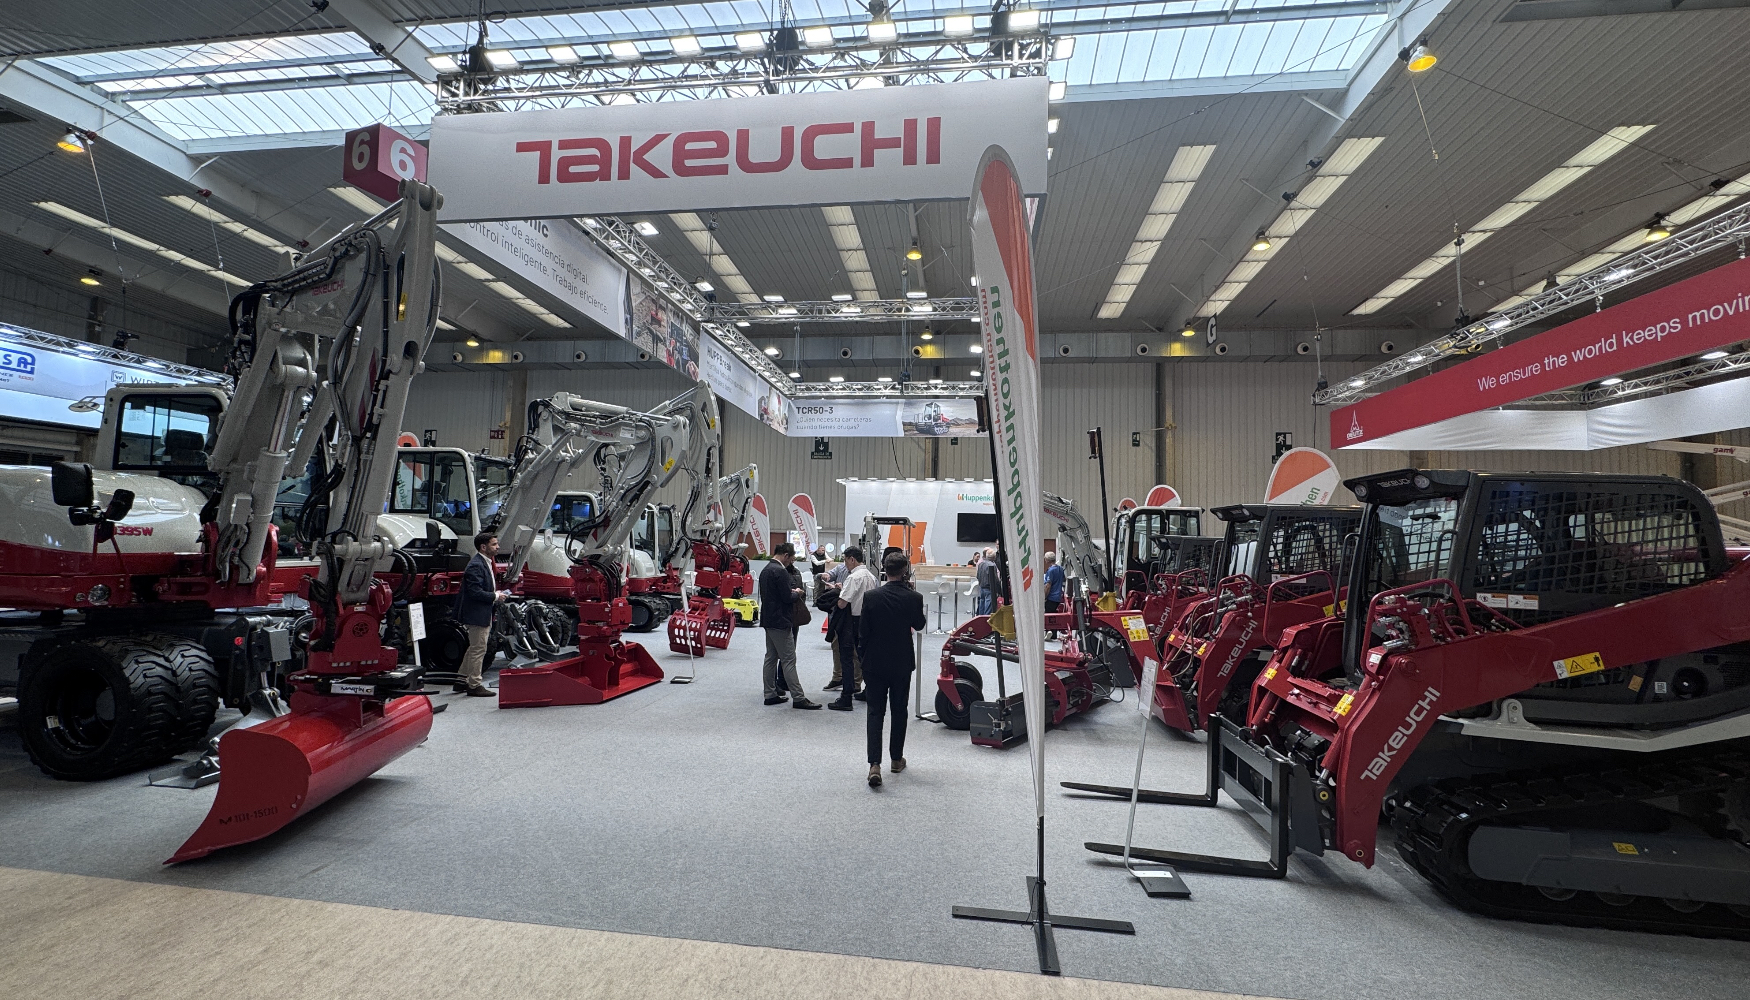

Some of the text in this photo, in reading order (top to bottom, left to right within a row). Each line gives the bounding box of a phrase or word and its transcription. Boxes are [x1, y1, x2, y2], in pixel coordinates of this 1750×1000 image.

[351, 131, 371, 171] 6
[390, 139, 416, 180] 6
[501, 240, 550, 278] inteligente.
[551, 268, 579, 297] Trabajo
[511, 223, 523, 240] de
[524, 233, 565, 269] asistencia
[566, 260, 590, 286] digital.
[1206, 316, 1217, 344] G
[1477, 375, 1497, 391] We
[1499, 361, 1541, 386] ensure
[1544, 353, 1568, 371] the
[1571, 333, 1617, 363] world
[1622, 316, 1681, 348] keeps
[796, 406, 834, 415] TCR50-3
